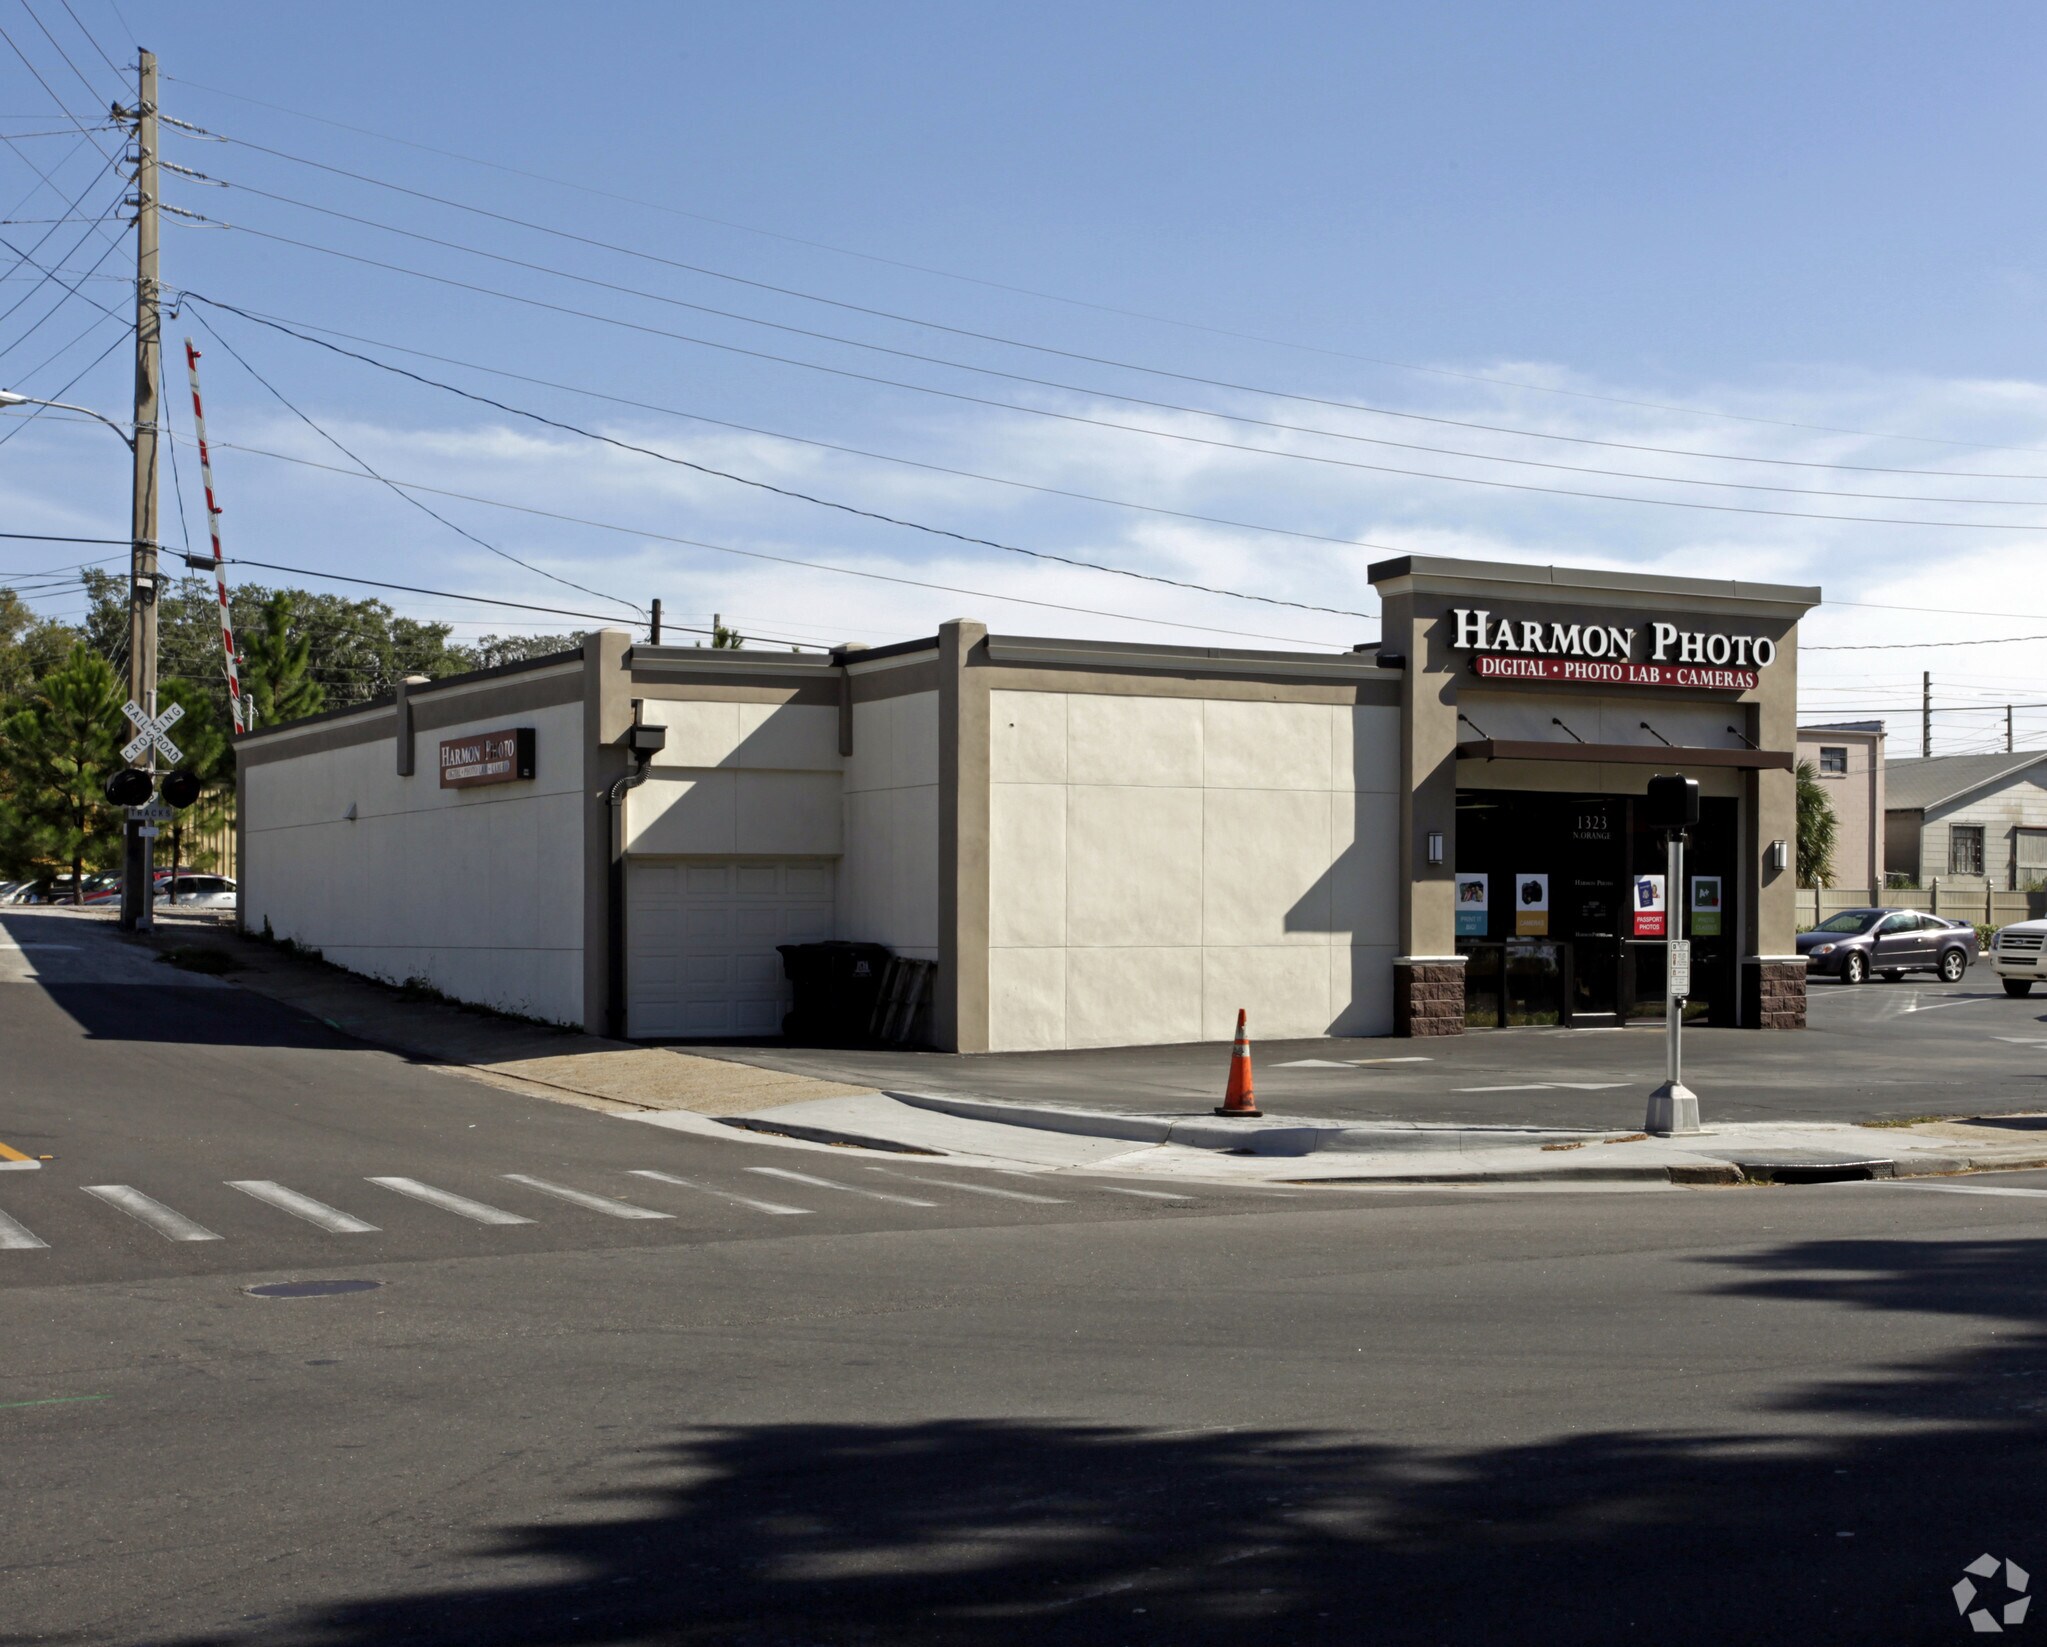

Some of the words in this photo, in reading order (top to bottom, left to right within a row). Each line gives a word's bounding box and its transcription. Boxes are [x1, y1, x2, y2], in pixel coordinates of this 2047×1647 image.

[1453, 608, 1634, 658] HARMON
[1652, 622, 1776, 667] PHOTO
[1482, 658, 1547, 677] DIGITAL
[1564, 661, 1623, 681] PHOTO
[1629, 665, 1660, 683] LAB
[1677, 668, 1753, 688] CAMERAS
[441, 745, 481, 767] HARMON
[131, 808, 171, 818] TRACKS
[1577, 815, 1608, 830] 1323
